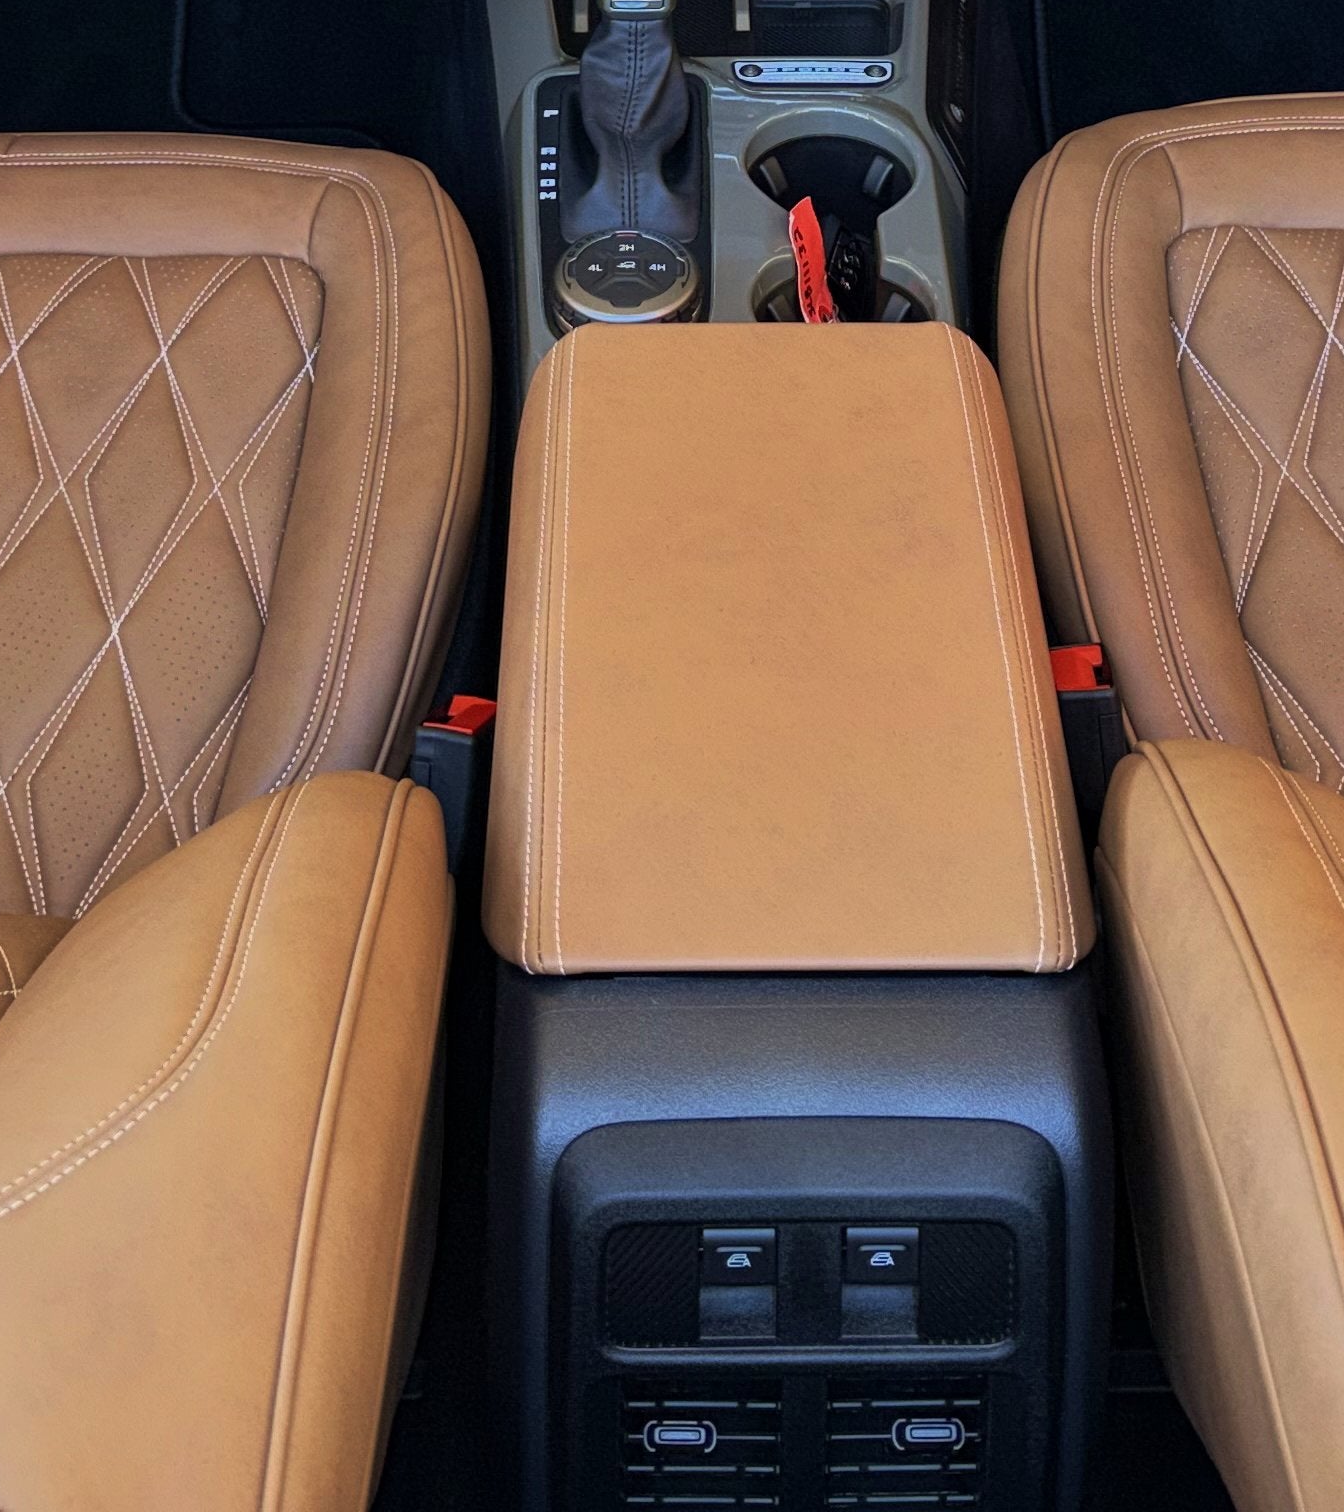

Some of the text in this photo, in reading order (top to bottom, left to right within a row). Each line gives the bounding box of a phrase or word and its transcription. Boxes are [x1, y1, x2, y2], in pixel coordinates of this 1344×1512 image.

[540, 162, 557, 171] N
[539, 191, 557, 201] M
[618, 244, 635, 252] 2H
[587, 263, 604, 272] 4L
[648, 263, 667, 272] 4H
